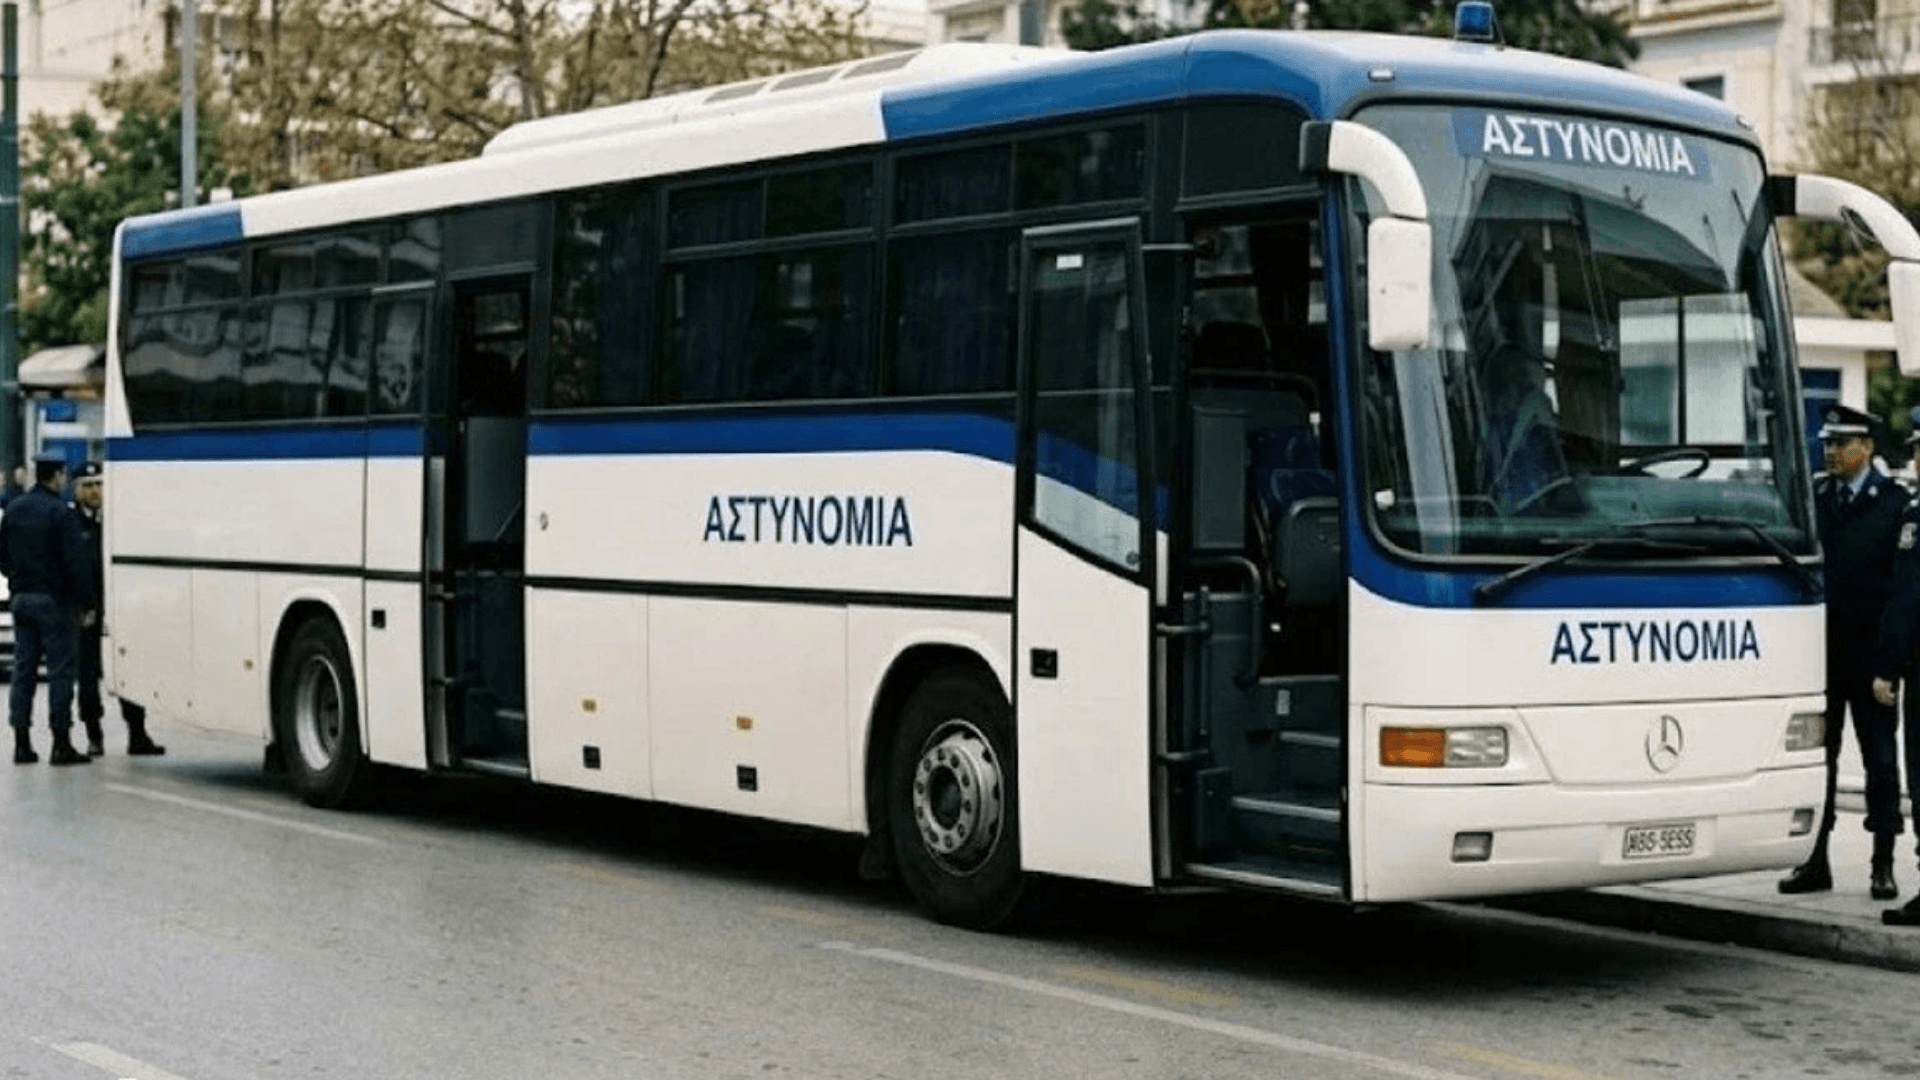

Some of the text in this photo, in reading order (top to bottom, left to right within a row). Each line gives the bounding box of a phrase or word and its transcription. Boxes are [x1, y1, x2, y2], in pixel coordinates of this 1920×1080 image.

[1483, 113, 1696, 176] ΑΣΤΥΝΟΜΙΑ
[703, 495, 913, 547] ΑΣΤΥΝΟΜΙΑ
[1550, 618, 1760, 664] ΑΣΤΥΝΟΜΙΑ
